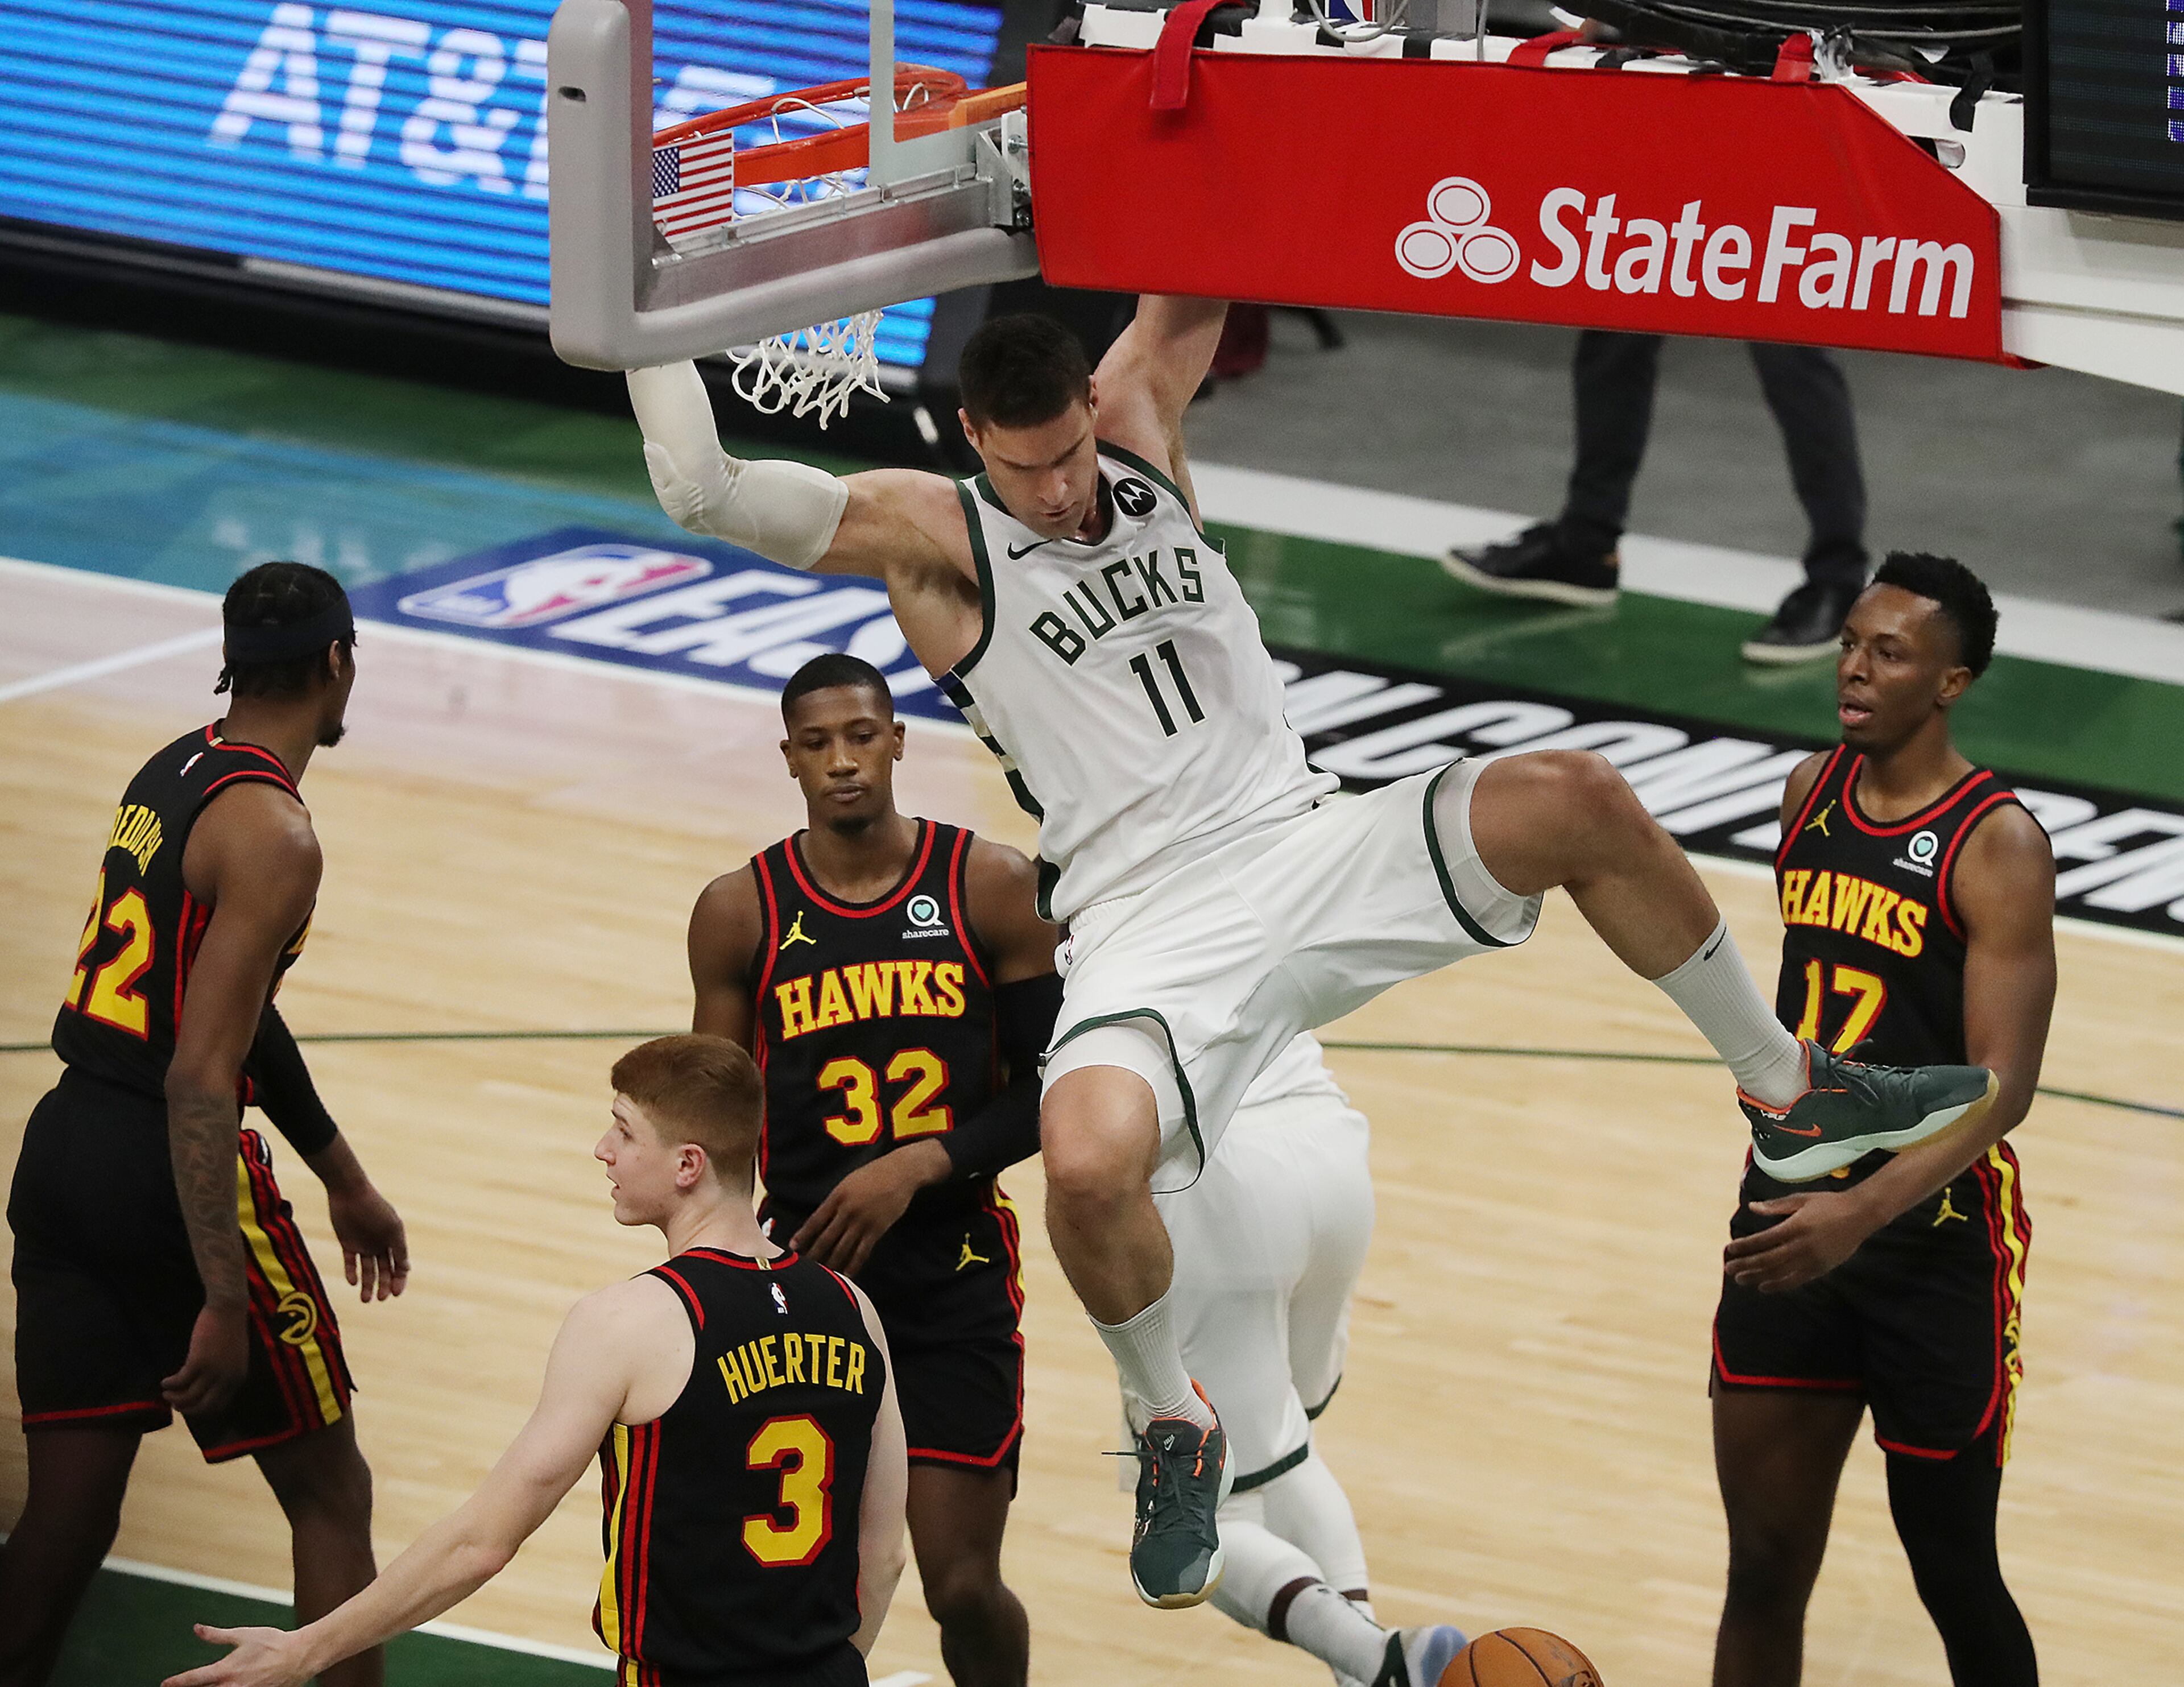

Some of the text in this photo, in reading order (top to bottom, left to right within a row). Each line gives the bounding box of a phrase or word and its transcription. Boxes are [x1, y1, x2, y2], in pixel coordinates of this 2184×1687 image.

[1029, 547, 1205, 665] BUCKS
[1129, 639, 1206, 739] 11
[902, 929, 949, 939] sharecare
[1781, 869, 1927, 958] HAWKS
[775, 959, 966, 1041] HAWKS
[1795, 958, 1888, 1056] 17
[817, 1048, 953, 1146] 32
[717, 1333, 865, 1405] HUERTER
[741, 1413, 834, 1568] 3
